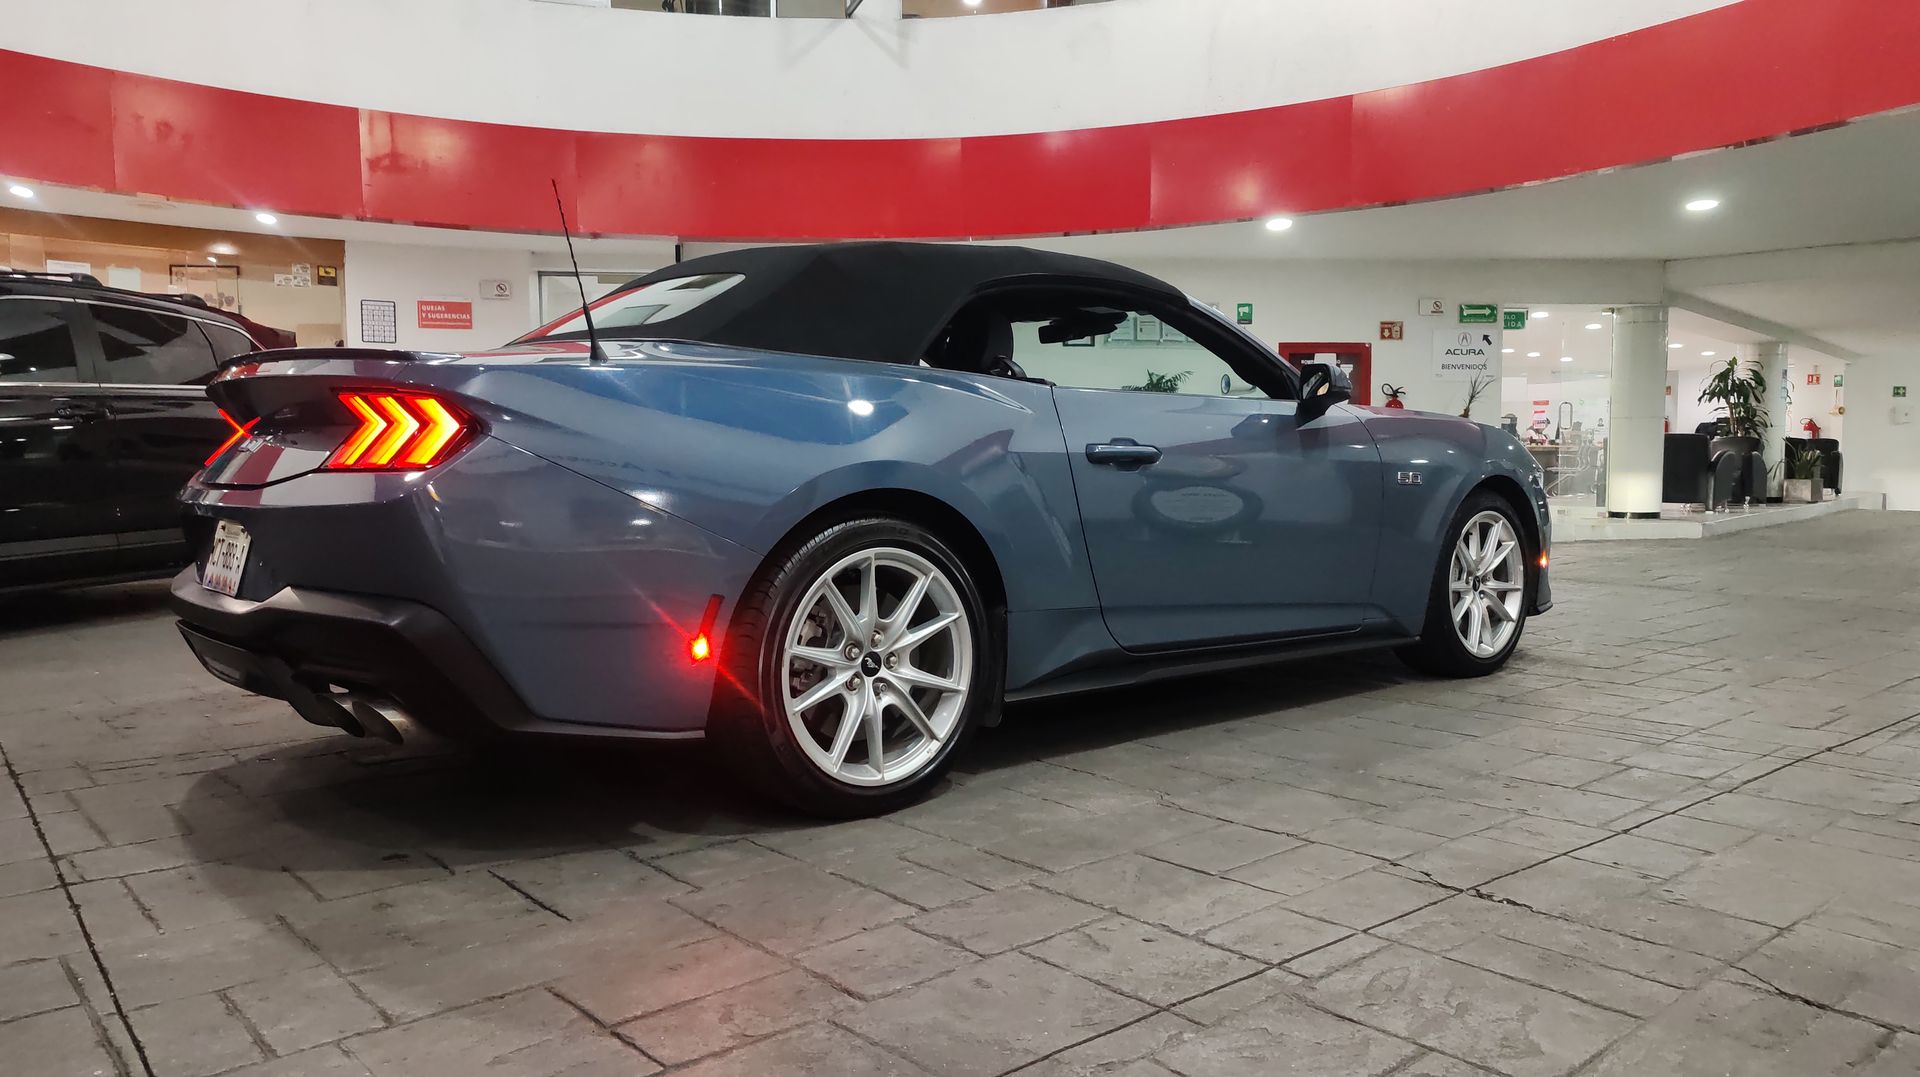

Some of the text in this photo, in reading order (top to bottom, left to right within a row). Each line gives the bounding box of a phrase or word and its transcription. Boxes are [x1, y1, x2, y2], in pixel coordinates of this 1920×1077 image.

[428, 312, 471, 320] SUGERENCIAS
[1445, 348, 1485, 356] ACURA
[1441, 363, 1488, 371] BIENVENIDOS
